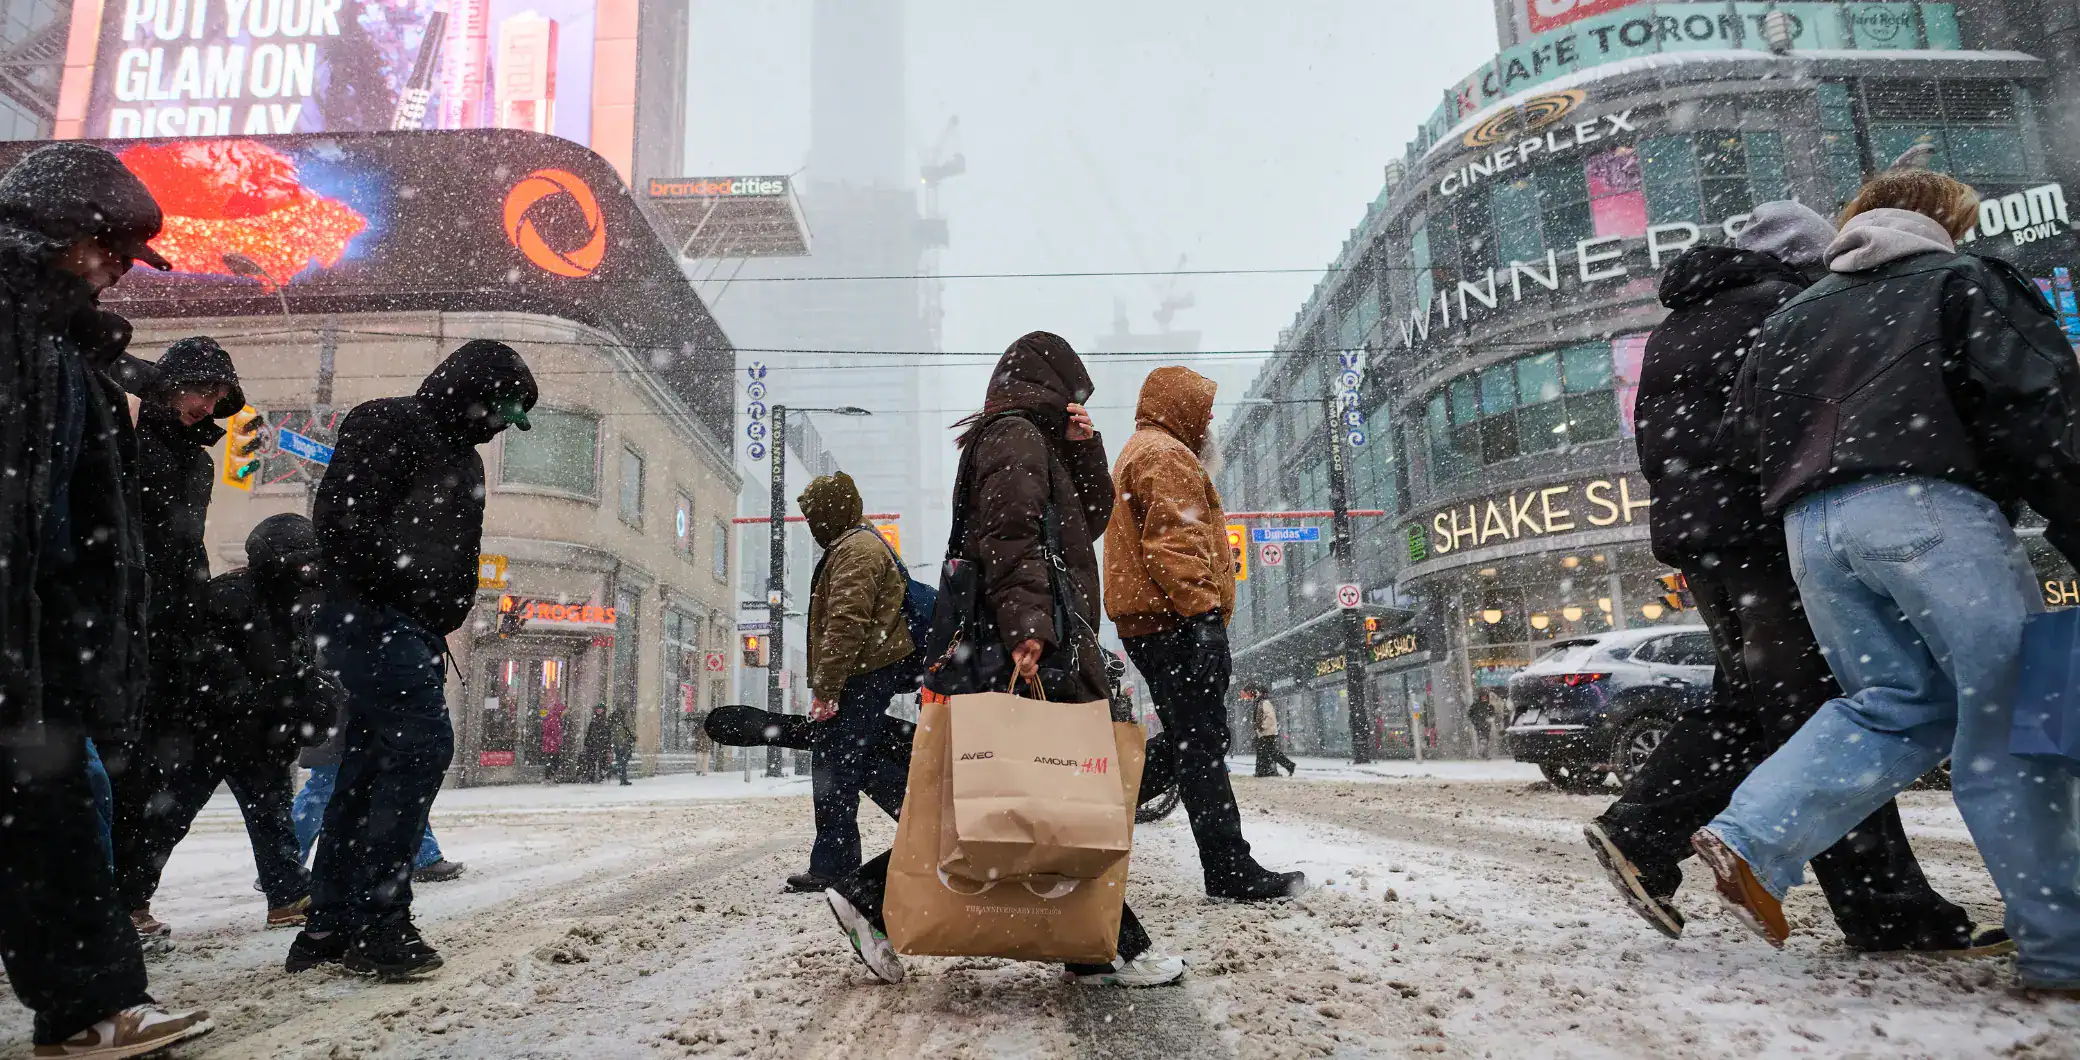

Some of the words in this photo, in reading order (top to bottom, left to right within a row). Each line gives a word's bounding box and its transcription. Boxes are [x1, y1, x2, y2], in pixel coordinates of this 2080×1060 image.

[122, 0, 208, 41] PUT
[224, 0, 341, 39] YOUR
[115, 46, 246, 102] GLAM
[249, 43, 317, 98] ON
[1482, 33, 1580, 98] CAFE
[108, 103, 303, 138] DISPLAY
[1440, 109, 1636, 196] CINEPLEX
[2012, 221, 2062, 246] BOWL
[1329, 400, 1342, 471] DOWNTOWN
[1264, 528, 1301, 540] Dundas
[1434, 485, 1576, 554] SHAKE
[537, 602, 617, 624] ROGERS
[960, 751, 994, 761] AVEC
[1034, 756, 1078, 767] AMOUR
[1081, 757, 1108, 774] H&M
